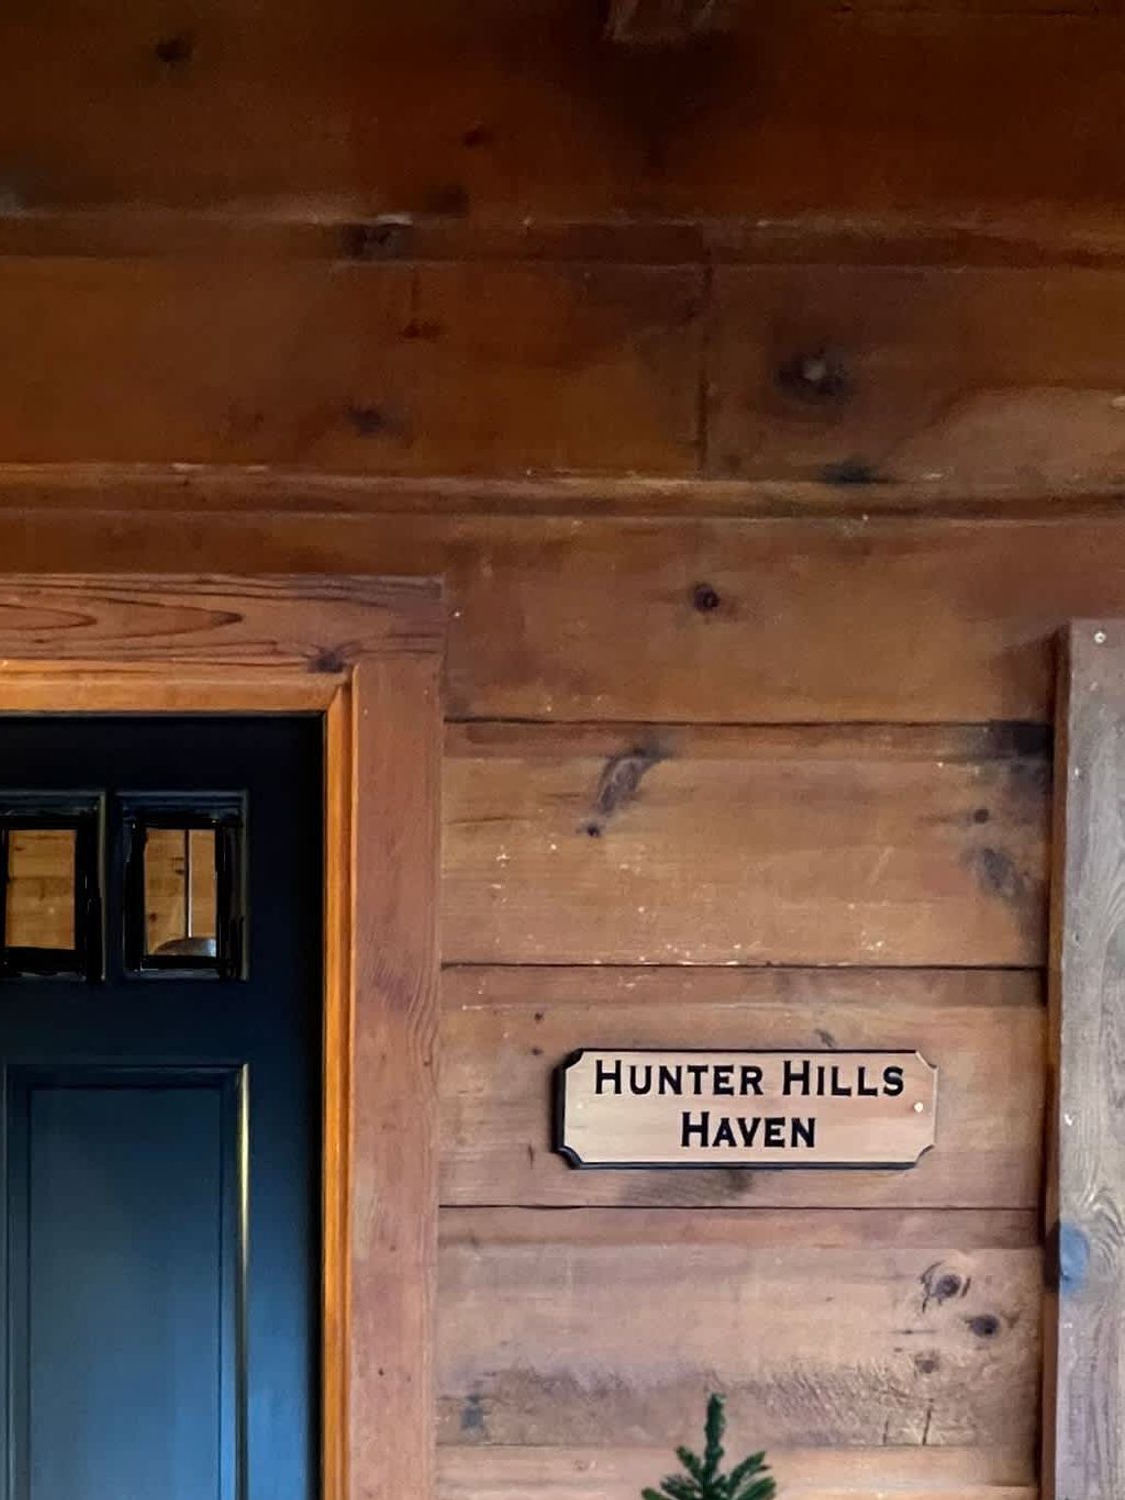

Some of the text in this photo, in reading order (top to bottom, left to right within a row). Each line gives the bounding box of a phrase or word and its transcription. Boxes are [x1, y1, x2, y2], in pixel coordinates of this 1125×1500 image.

[595, 1059, 905, 1097] HUNTER HILLS
[680, 1111, 816, 1148] HAVEN
